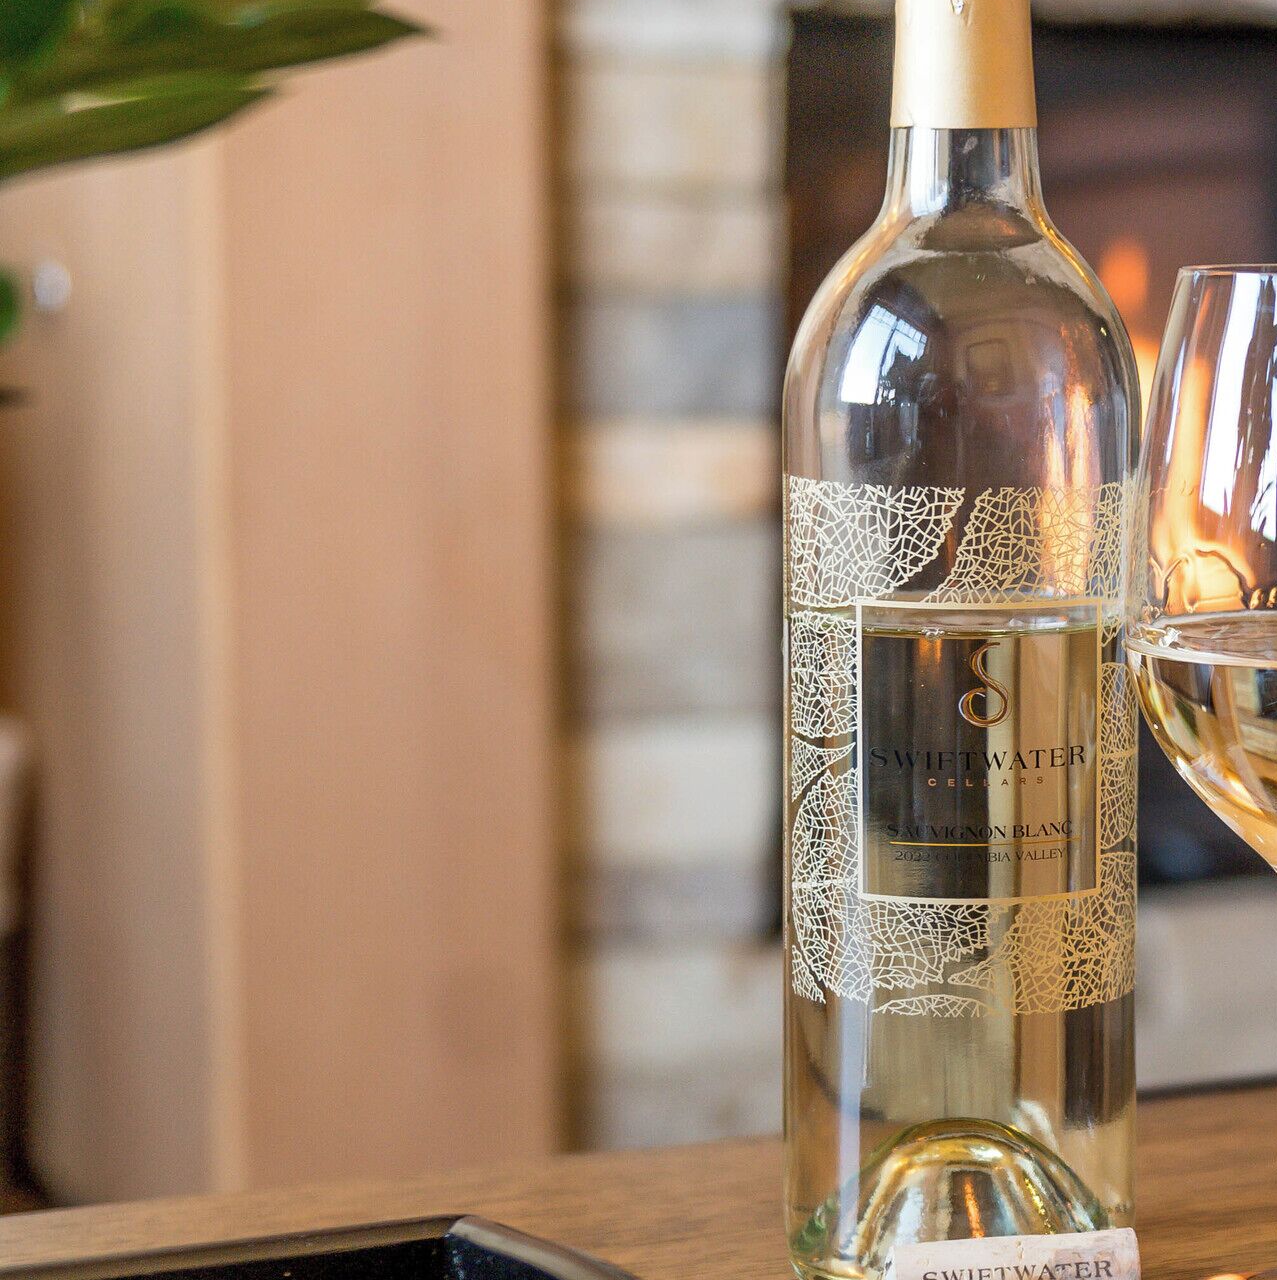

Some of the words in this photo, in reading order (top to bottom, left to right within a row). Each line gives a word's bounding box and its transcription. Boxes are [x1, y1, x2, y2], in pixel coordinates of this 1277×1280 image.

[870, 745, 1085, 770] SWIFTWATER
[927, 776, 1044, 787] CELLARS
[886, 823, 1007, 840] SAUVIGNON
[1012, 819, 1073, 839] BLANC
[894, 850, 931, 862] 2022
[1015, 847, 1066, 861] VALLEY
